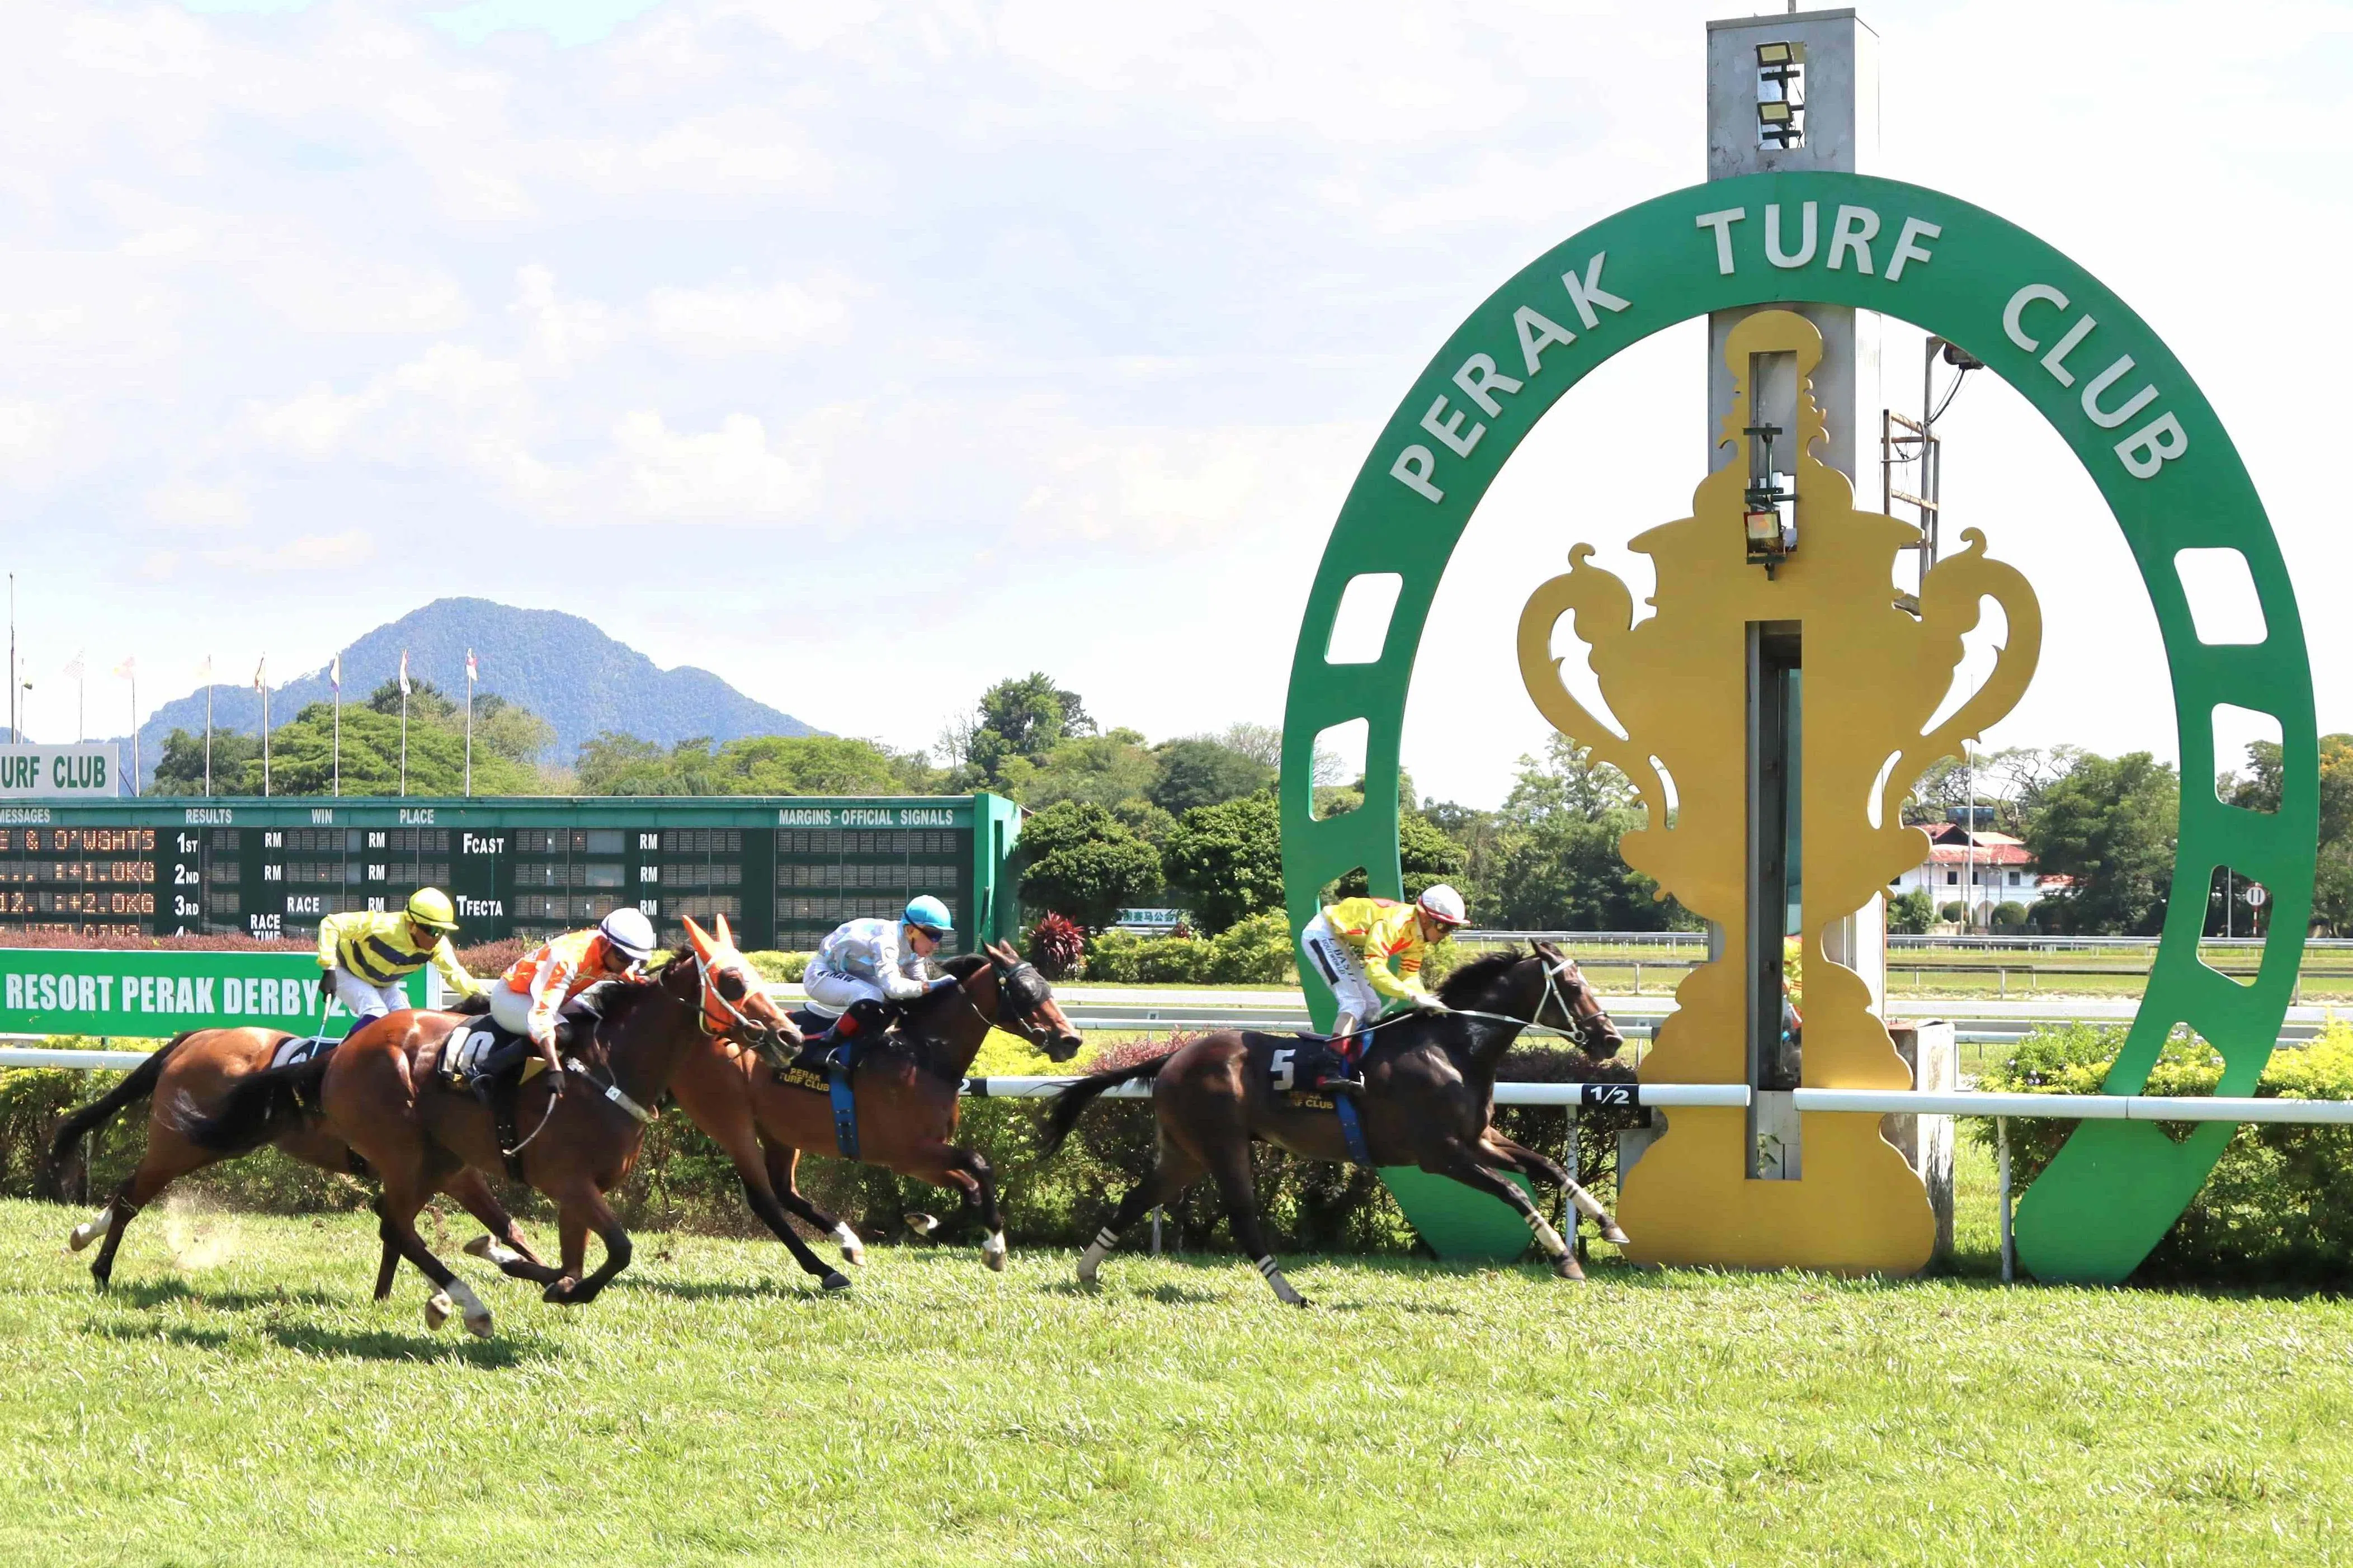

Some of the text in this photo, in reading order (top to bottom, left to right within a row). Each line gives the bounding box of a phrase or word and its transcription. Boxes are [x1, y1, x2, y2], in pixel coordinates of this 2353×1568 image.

[1389, 201, 2189, 504] PERAK TURF CLUB
[53, 755, 106, 788] CLUB
[186, 809, 232, 824] RESULTS
[312, 809, 333, 824] WIN
[400, 809, 434, 824] PLACE
[779, 809, 831, 825] MARGINS
[841, 809, 893, 825] OFFICIAL
[900, 809, 953, 825] SIGNALS
[177, 832, 198, 853] 1ST
[265, 832, 281, 847] RM
[369, 832, 385, 847] RM
[639, 834, 657, 849] RM
[174, 863, 199, 884] 2ND
[264, 865, 281, 880] RM
[368, 865, 385, 880] RM
[640, 866, 657, 882] RM
[175, 895, 199, 915] 3RD
[287, 897, 319, 912] RACE
[368, 897, 384, 913] RM
[640, 900, 657, 915] RM
[251, 914, 280, 929] RACE
[6, 974, 114, 1011] RESORT
[122, 976, 215, 1013] PERAK
[224, 977, 320, 1016] DERBY
[790, 1068, 821, 1081] PERAK
[1270, 1049, 1296, 1090] 5
[804, 1079, 830, 1092] CLUB
[1590, 1085, 1630, 1104] 1/2
[1305, 1099, 1335, 1109] CLUB
